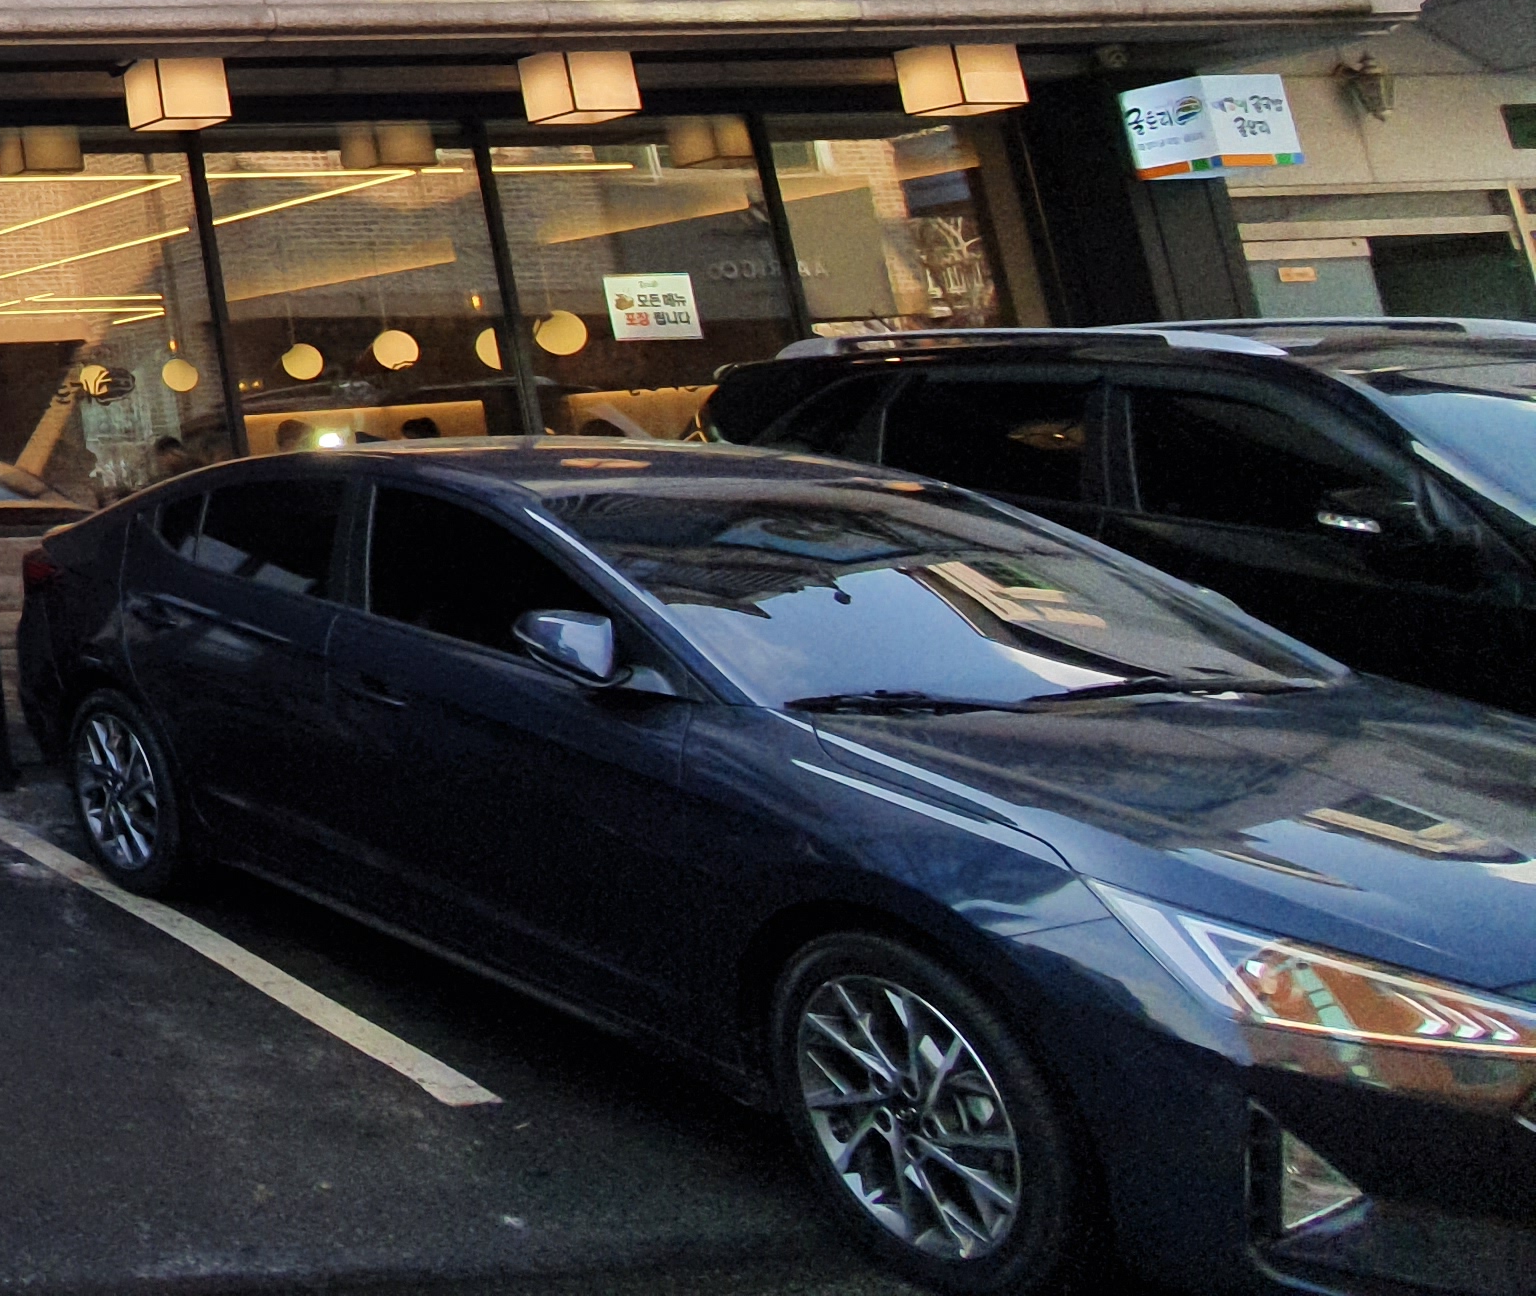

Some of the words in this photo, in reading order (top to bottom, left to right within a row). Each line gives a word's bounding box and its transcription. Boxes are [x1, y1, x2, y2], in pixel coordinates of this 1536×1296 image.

[1124, 107, 1174, 136] 굴토리
[636, 293, 662, 308] 모든
[662, 292, 687, 308] 메뉴
[625, 311, 650, 327] 포장
